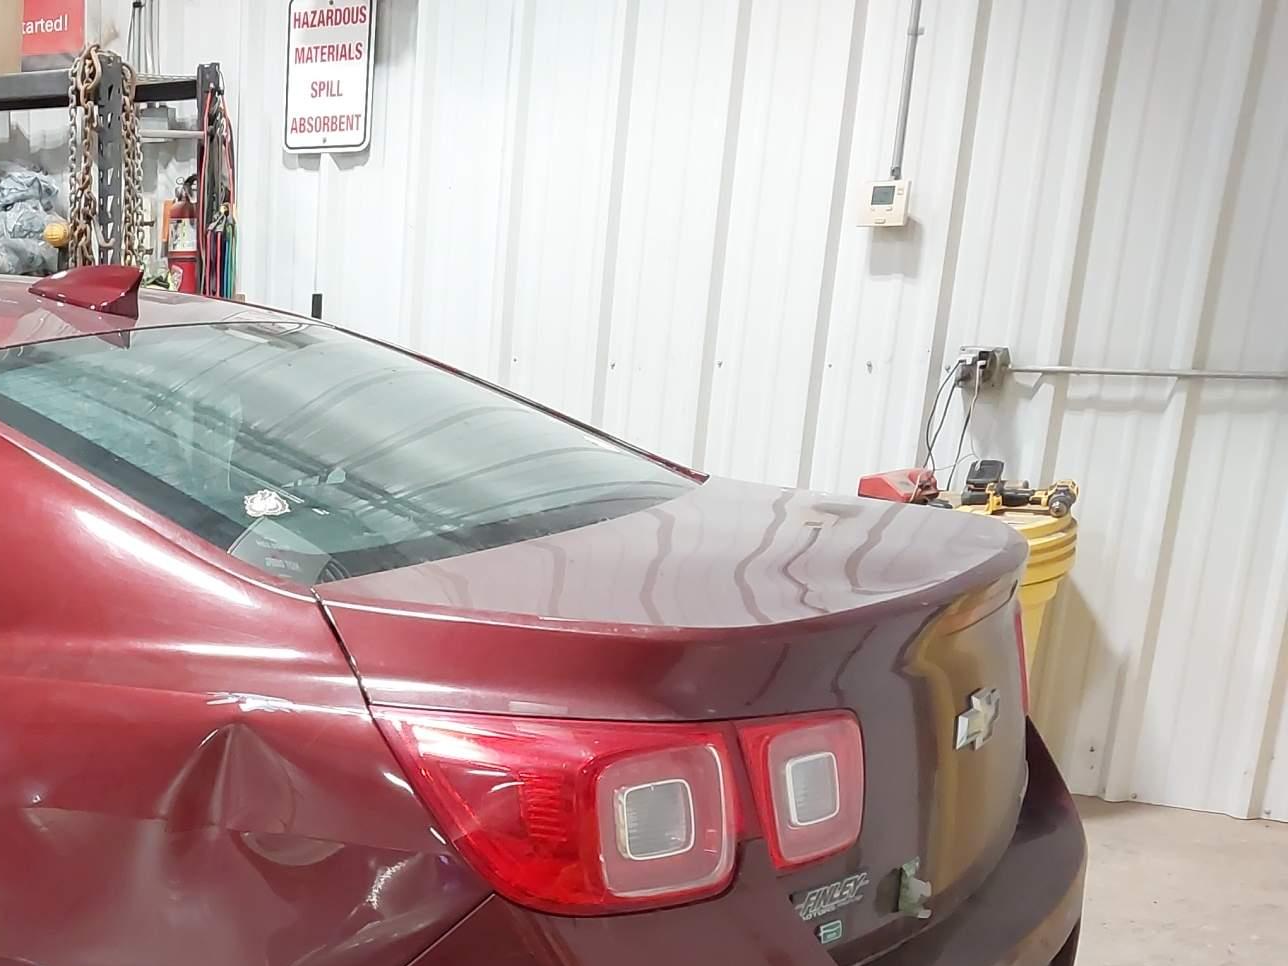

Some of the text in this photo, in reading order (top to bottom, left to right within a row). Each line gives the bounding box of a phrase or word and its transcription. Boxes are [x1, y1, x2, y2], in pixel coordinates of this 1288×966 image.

[293, 5, 367, 29] HAZARDOUS
[294, 42, 363, 65] MATERIALS
[310, 80, 343, 98] SPILL
[290, 114, 362, 134] ABSORBENT
[800, 872, 868, 917] FINLEY
